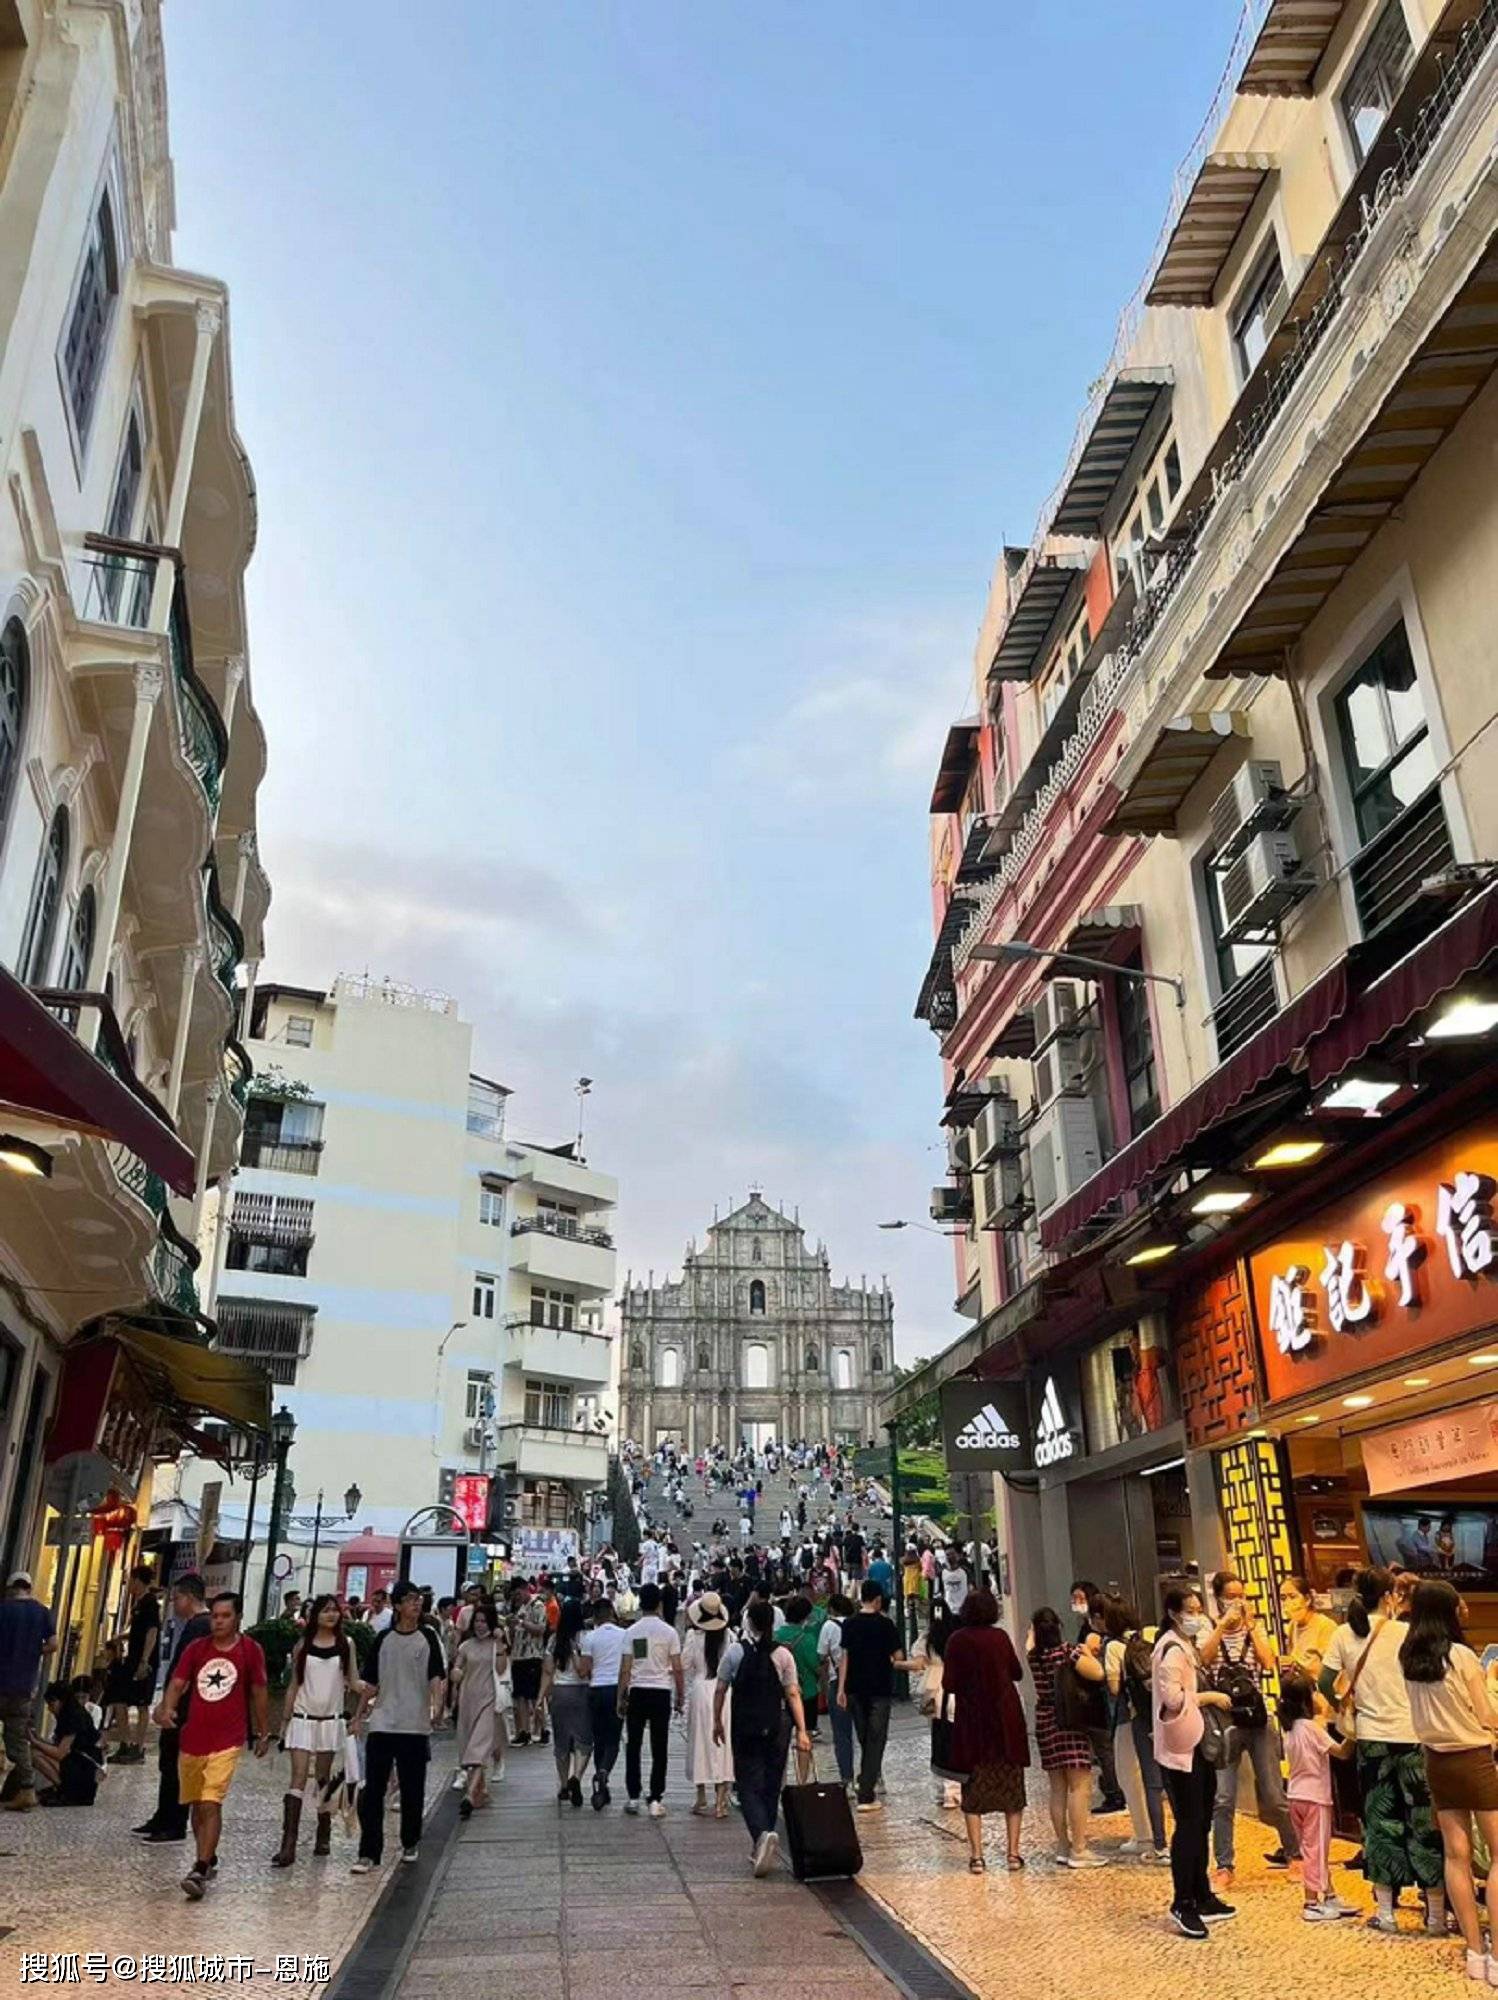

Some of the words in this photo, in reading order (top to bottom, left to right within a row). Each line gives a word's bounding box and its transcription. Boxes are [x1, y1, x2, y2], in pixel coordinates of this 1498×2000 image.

[1269, 1171, 1493, 1354] 鉅記手信
[955, 1430, 1021, 1449] adidas
[1034, 1430, 1073, 1468] adidas
